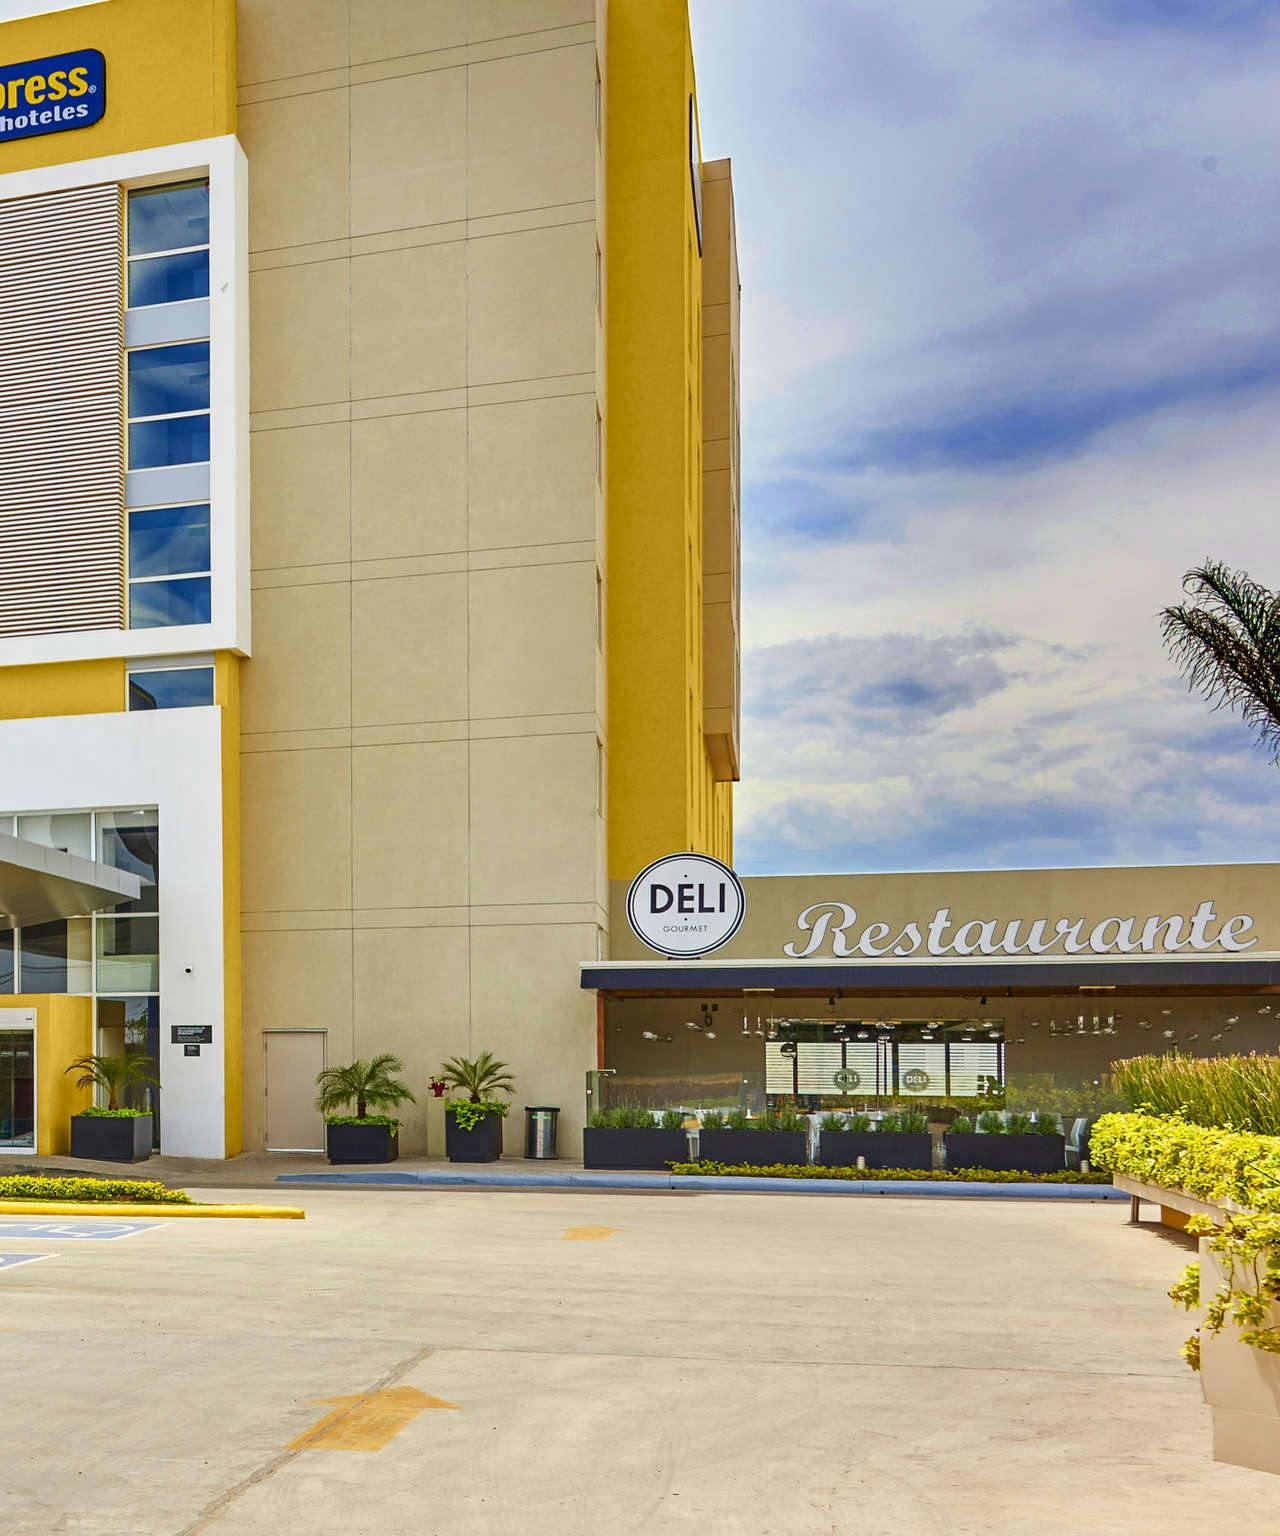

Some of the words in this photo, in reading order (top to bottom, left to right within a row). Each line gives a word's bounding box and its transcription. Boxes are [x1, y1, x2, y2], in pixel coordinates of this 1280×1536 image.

[0, 103, 89, 132] hoteles
[650, 883, 726, 914] DELI
[662, 924, 709, 933] GOURMET
[782, 900, 1259, 958] Restaurante
[905, 1075, 927, 1084] DELI
